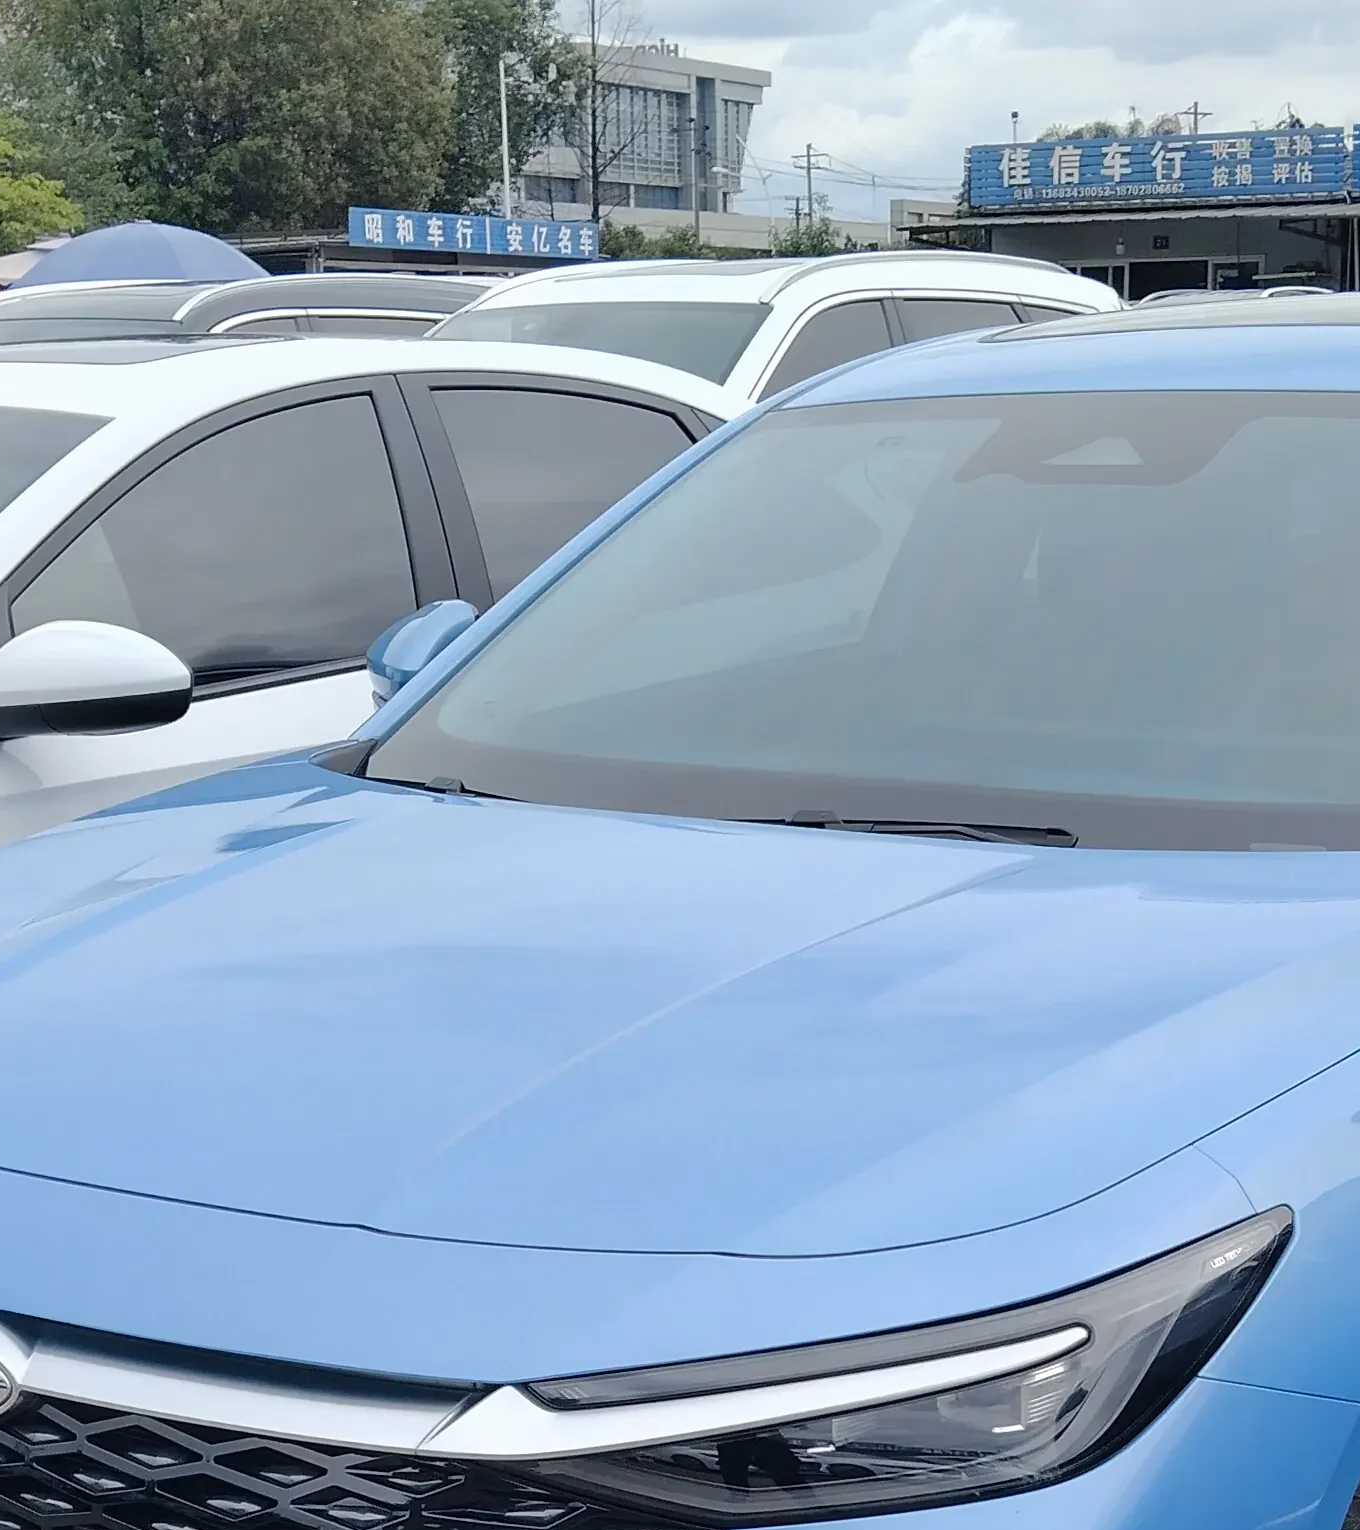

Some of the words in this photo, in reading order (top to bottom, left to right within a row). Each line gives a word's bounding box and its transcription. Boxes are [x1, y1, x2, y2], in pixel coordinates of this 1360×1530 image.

[1212, 138, 1253, 160] 收售
[1272, 134, 1313, 158] 置换
[998, 141, 1187, 188] 佳信车行
[1211, 164, 1253, 187] 按揭
[1272, 161, 1313, 184] 评估
[364, 214, 474, 249] 昭和车行
[506, 222, 594, 256] 安亿名车
